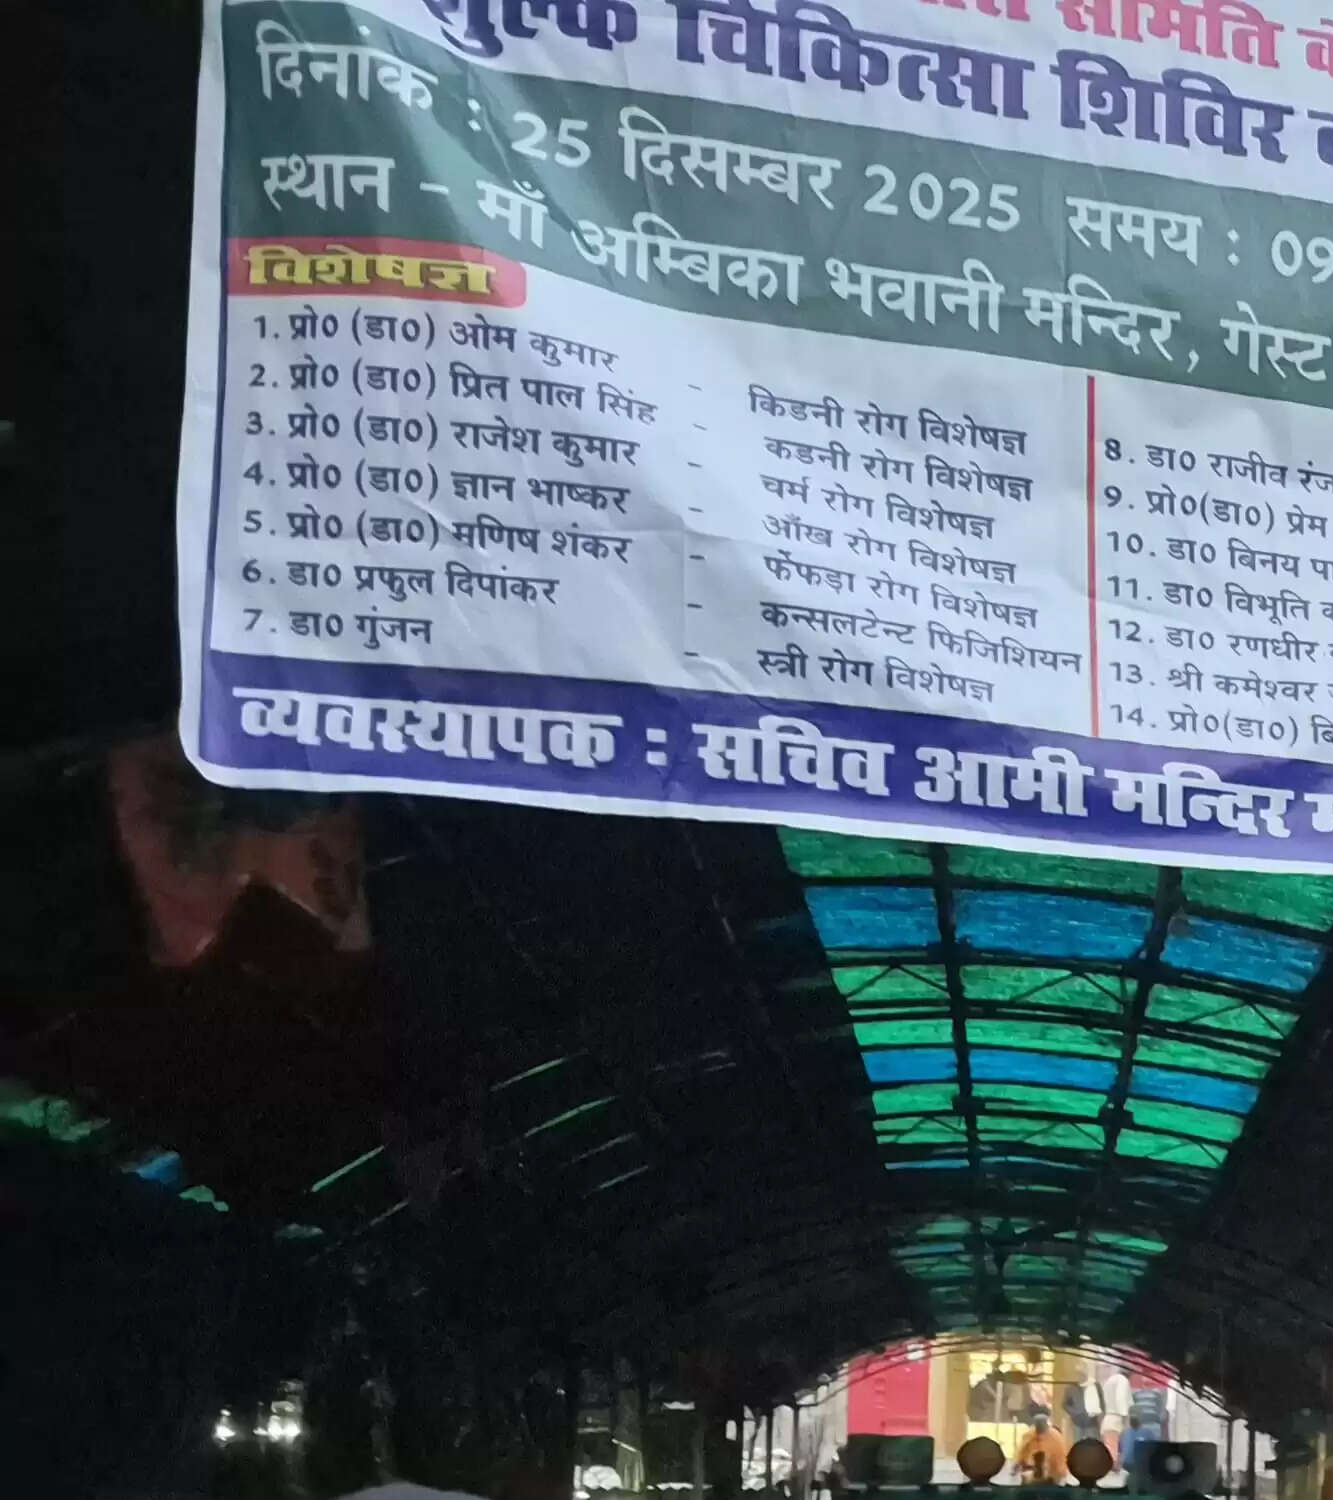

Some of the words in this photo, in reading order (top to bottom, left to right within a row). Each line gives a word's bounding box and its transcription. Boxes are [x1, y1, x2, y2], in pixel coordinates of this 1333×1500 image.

[676, 0, 1034, 119] चिकित्सा
[1050, 49, 1293, 163] शिविर
[255, 18, 438, 110] दिनांक
[511, 112, 591, 168] 25
[618, 106, 841, 210] दिसम्बर
[864, 164, 1021, 232] 2025
[1065, 196, 1202, 266] समय
[243, 244, 497, 294] विशेषज्ञ
[261, 154, 395, 213] स्थान
[476, 180, 550, 250] माँ
[572, 212, 804, 306] अम्बिका
[825, 258, 1005, 334] भवानी
[1220, 300, 1331, 381] गेस्ट
[254, 315, 279, 339] 1.
[450, 314, 517, 352] ओम
[528, 331, 619, 372] कुमार
[248, 364, 278, 388] 2.
[520, 378, 585, 410] पाल
[597, 381, 658, 425] सिंह
[748, 384, 845, 429] किडनी
[855, 402, 908, 441] रोग
[918, 408, 1027, 456] विशेषज्ञ
[245, 411, 276, 436] 3.
[449, 416, 541, 454] राजेश
[551, 430, 641, 468] कुमार
[1104, 438, 1135, 464] 8.
[1207, 451, 1288, 488] राजीव
[243, 461, 275, 486] 4.
[451, 472, 516, 501] ज्ञान
[860, 449, 914, 483] रोग
[924, 454, 1033, 502] विशेषज्ञ
[760, 473, 809, 504] चर्म
[821, 483, 874, 519] रोग
[885, 492, 995, 539] विशेषज्ञ
[1104, 485, 1134, 510] 9.
[1286, 504, 1327, 538] प्रेम
[243, 509, 276, 536] 5.
[452, 513, 540, 553] मणिष
[551, 522, 632, 563] शंकर
[843, 528, 896, 561] रोग
[909, 538, 1016, 584] विशेषज्ञ
[1106, 531, 1156, 557] 10.
[1227, 537, 1299, 578] बिनय
[242, 559, 276, 585] 6.
[354, 564, 435, 602] प्रफुल
[445, 561, 559, 604] दिपांकर
[867, 570, 919, 605] रोग
[931, 583, 1039, 629] विशेषज्ञ
[1107, 576, 1152, 601] 11.
[1225, 582, 1310, 625] विभूति
[243, 608, 277, 633] 7.
[354, 605, 433, 650] गुंजन
[927, 620, 1082, 674] फिजिशियन
[1108, 619, 1154, 644] 12.
[1226, 631, 1320, 662] रणधीर
[756, 642, 808, 679] स्त्री
[818, 648, 874, 685] रोग
[885, 656, 995, 703] विशेषज्ञ
[1109, 662, 1155, 686] 13.
[1167, 662, 1203, 692] श्री
[1110, 705, 1157, 728] 14.
[233, 686, 624, 768] व्यवस्थापक
[692, 714, 895, 796] सचिव
[914, 745, 1095, 817] आमी
[1104, 761, 1296, 838] मन्दिर
